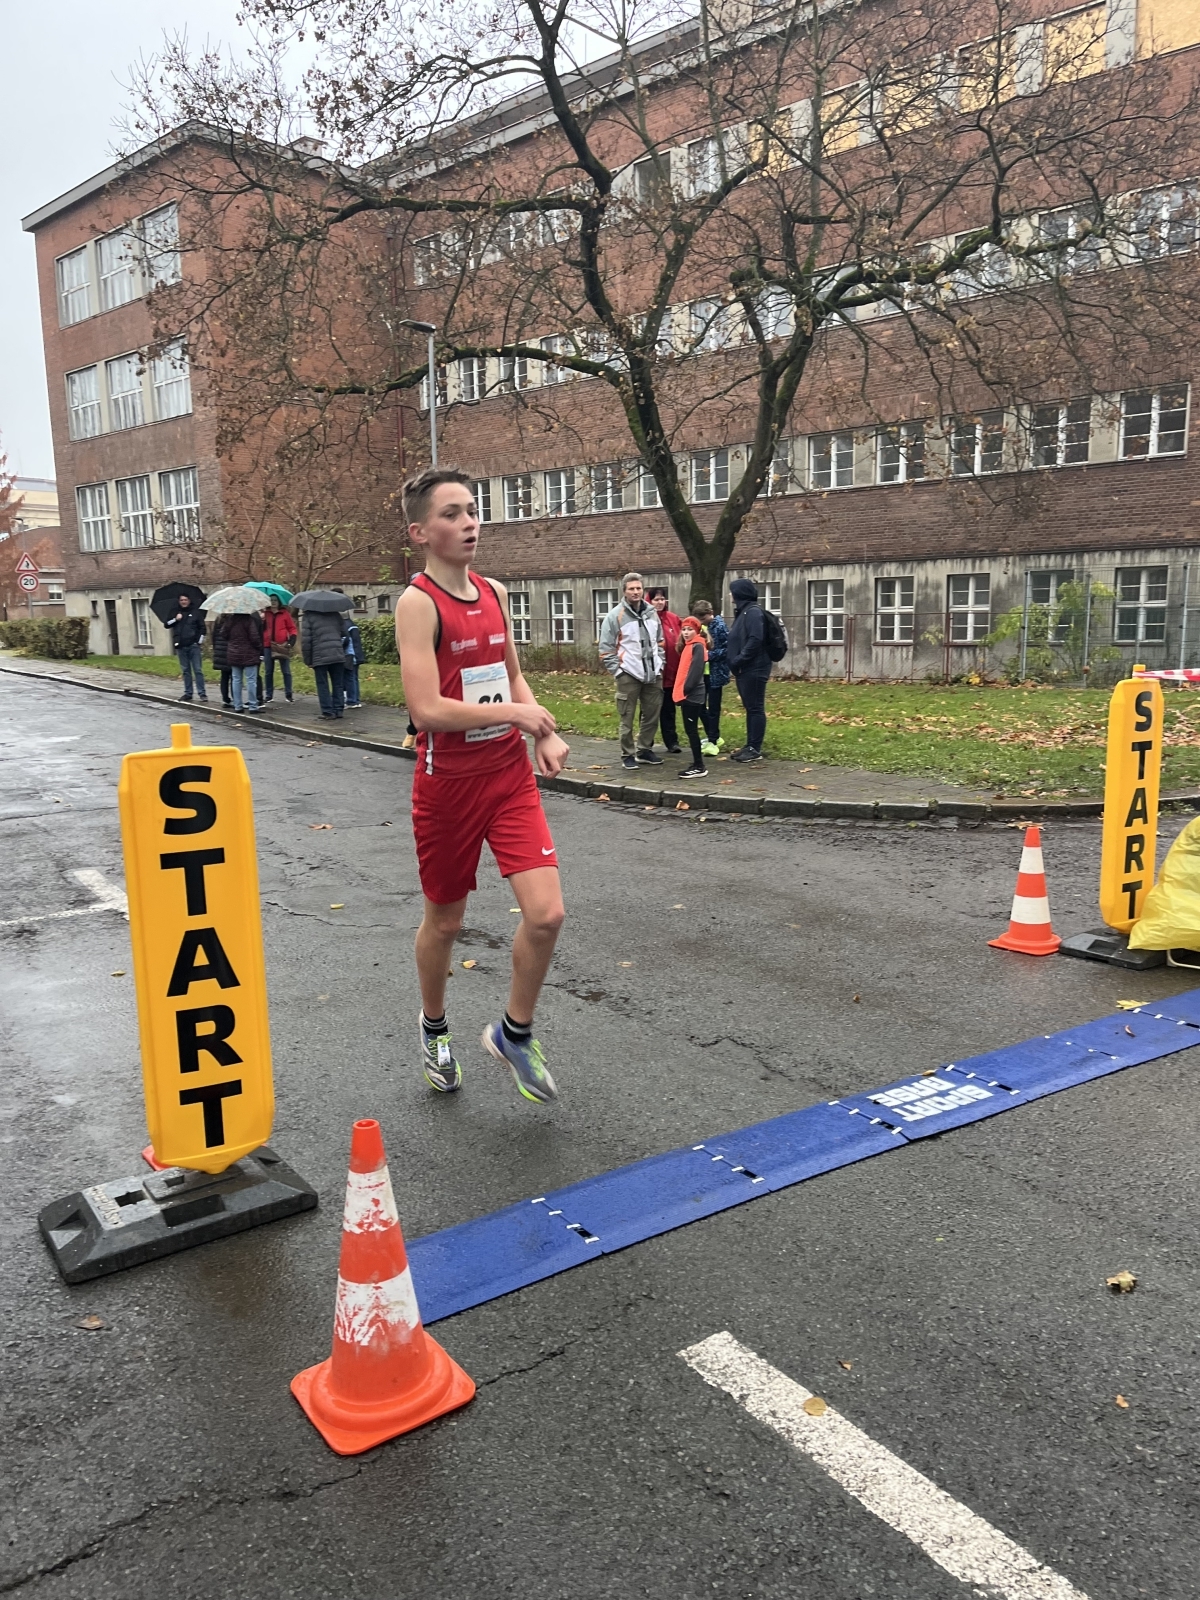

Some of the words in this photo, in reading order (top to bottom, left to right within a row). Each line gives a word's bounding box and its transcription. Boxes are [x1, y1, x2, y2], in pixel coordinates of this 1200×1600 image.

[23, 578, 35, 586] 20
[1122, 691, 1153, 919] START
[159, 765, 243, 1148] START
[866, 1076, 957, 1108] BASE
[892, 1084, 994, 1122] SPORT
